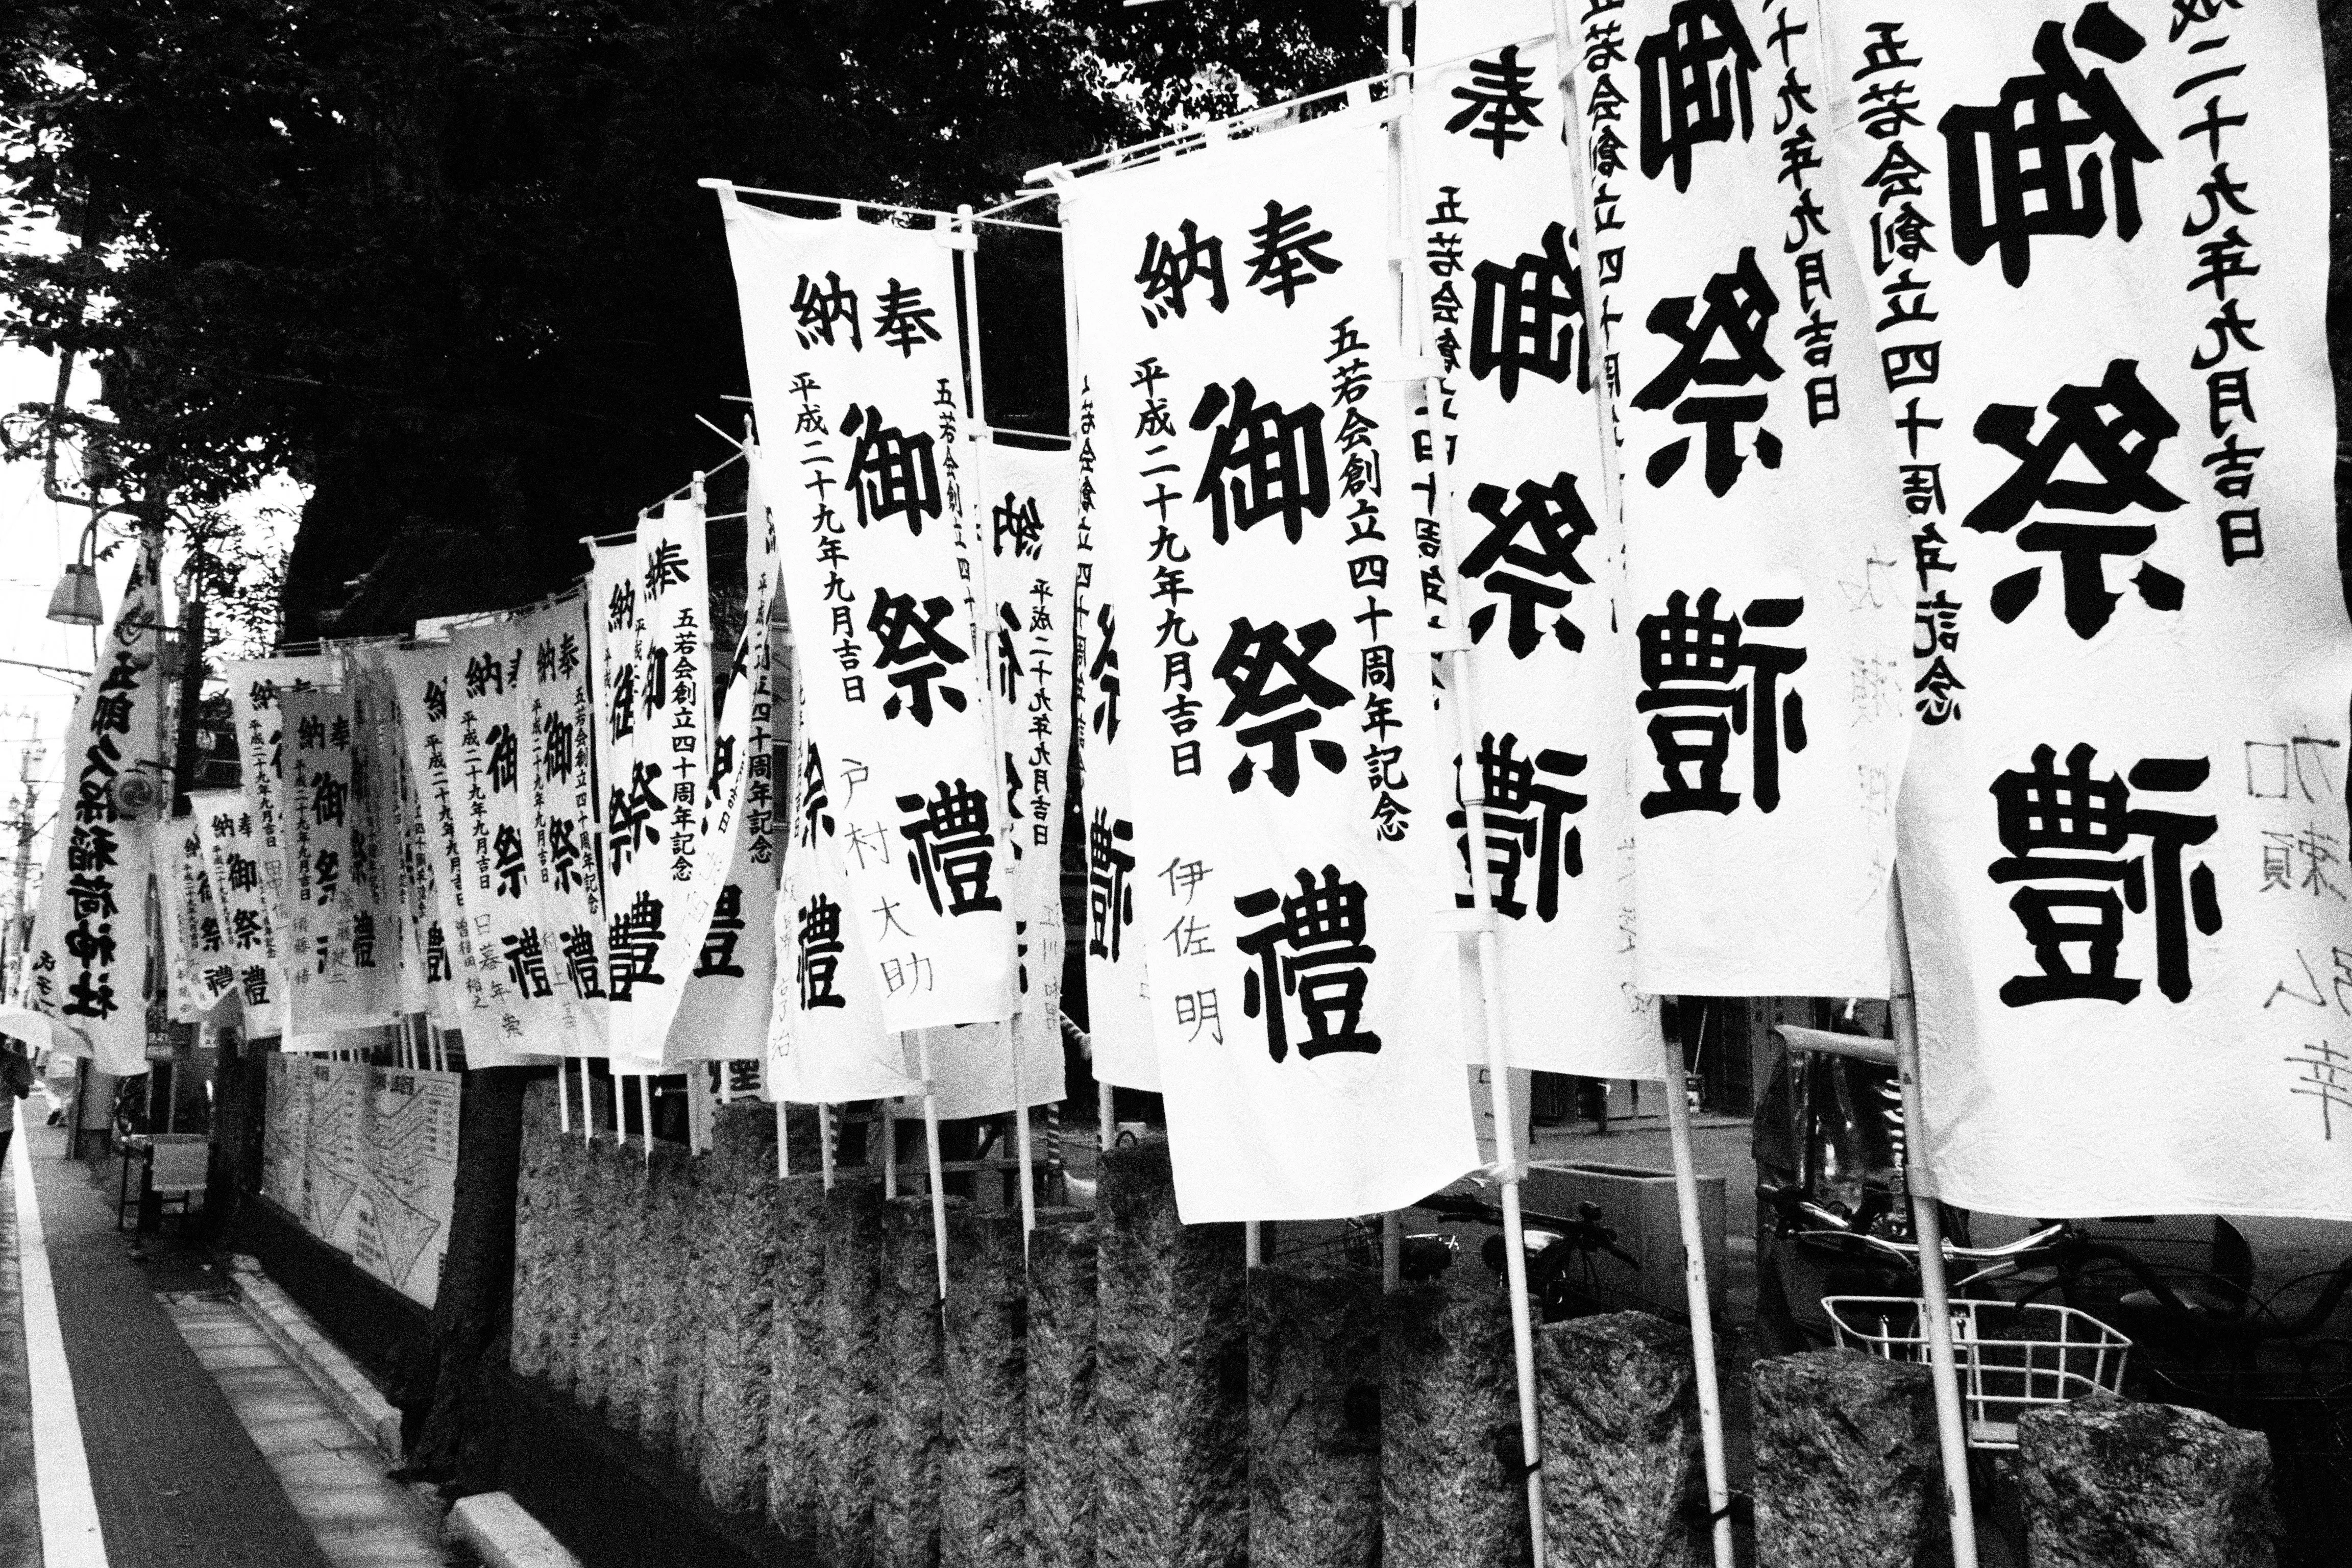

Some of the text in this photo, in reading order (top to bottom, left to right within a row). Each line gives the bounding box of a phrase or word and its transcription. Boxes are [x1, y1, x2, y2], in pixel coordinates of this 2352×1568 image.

[790, 270, 943, 359] 奉納
[1134, 199, 1343, 329] 奉納
[789, 371, 866, 703] 平成二十九年九月吉日
[1130, 356, 1202, 777] 平成二十九年九月吉日
[1324, 315, 1412, 842] 五若会創立四十周年記念
[298, 715, 350, 750] 奉納
[536, 632, 580, 685] 奉納
[670, 608, 698, 882] 五若会創立四十周年記念
[839, 402, 1002, 918] 御祭禮
[1189, 377, 1382, 1064] 御祭禮
[212, 813, 252, 838] 奉納
[250, 720, 276, 846] 平成二十九年九月吉日
[294, 759, 311, 900] 平成二十九年九月吉日
[461, 710, 491, 890] 平成二十九年九月吉日
[485, 723, 553, 999] 御祭禮
[531, 698, 549, 884] 平成二十九年九月吉日
[543, 710, 607, 1000] 御祭禮
[228, 853, 271, 1006] 御祭禮
[840, 757, 934, 998] 戸村大助
[1157, 856, 1224, 1045] 伊佐明
